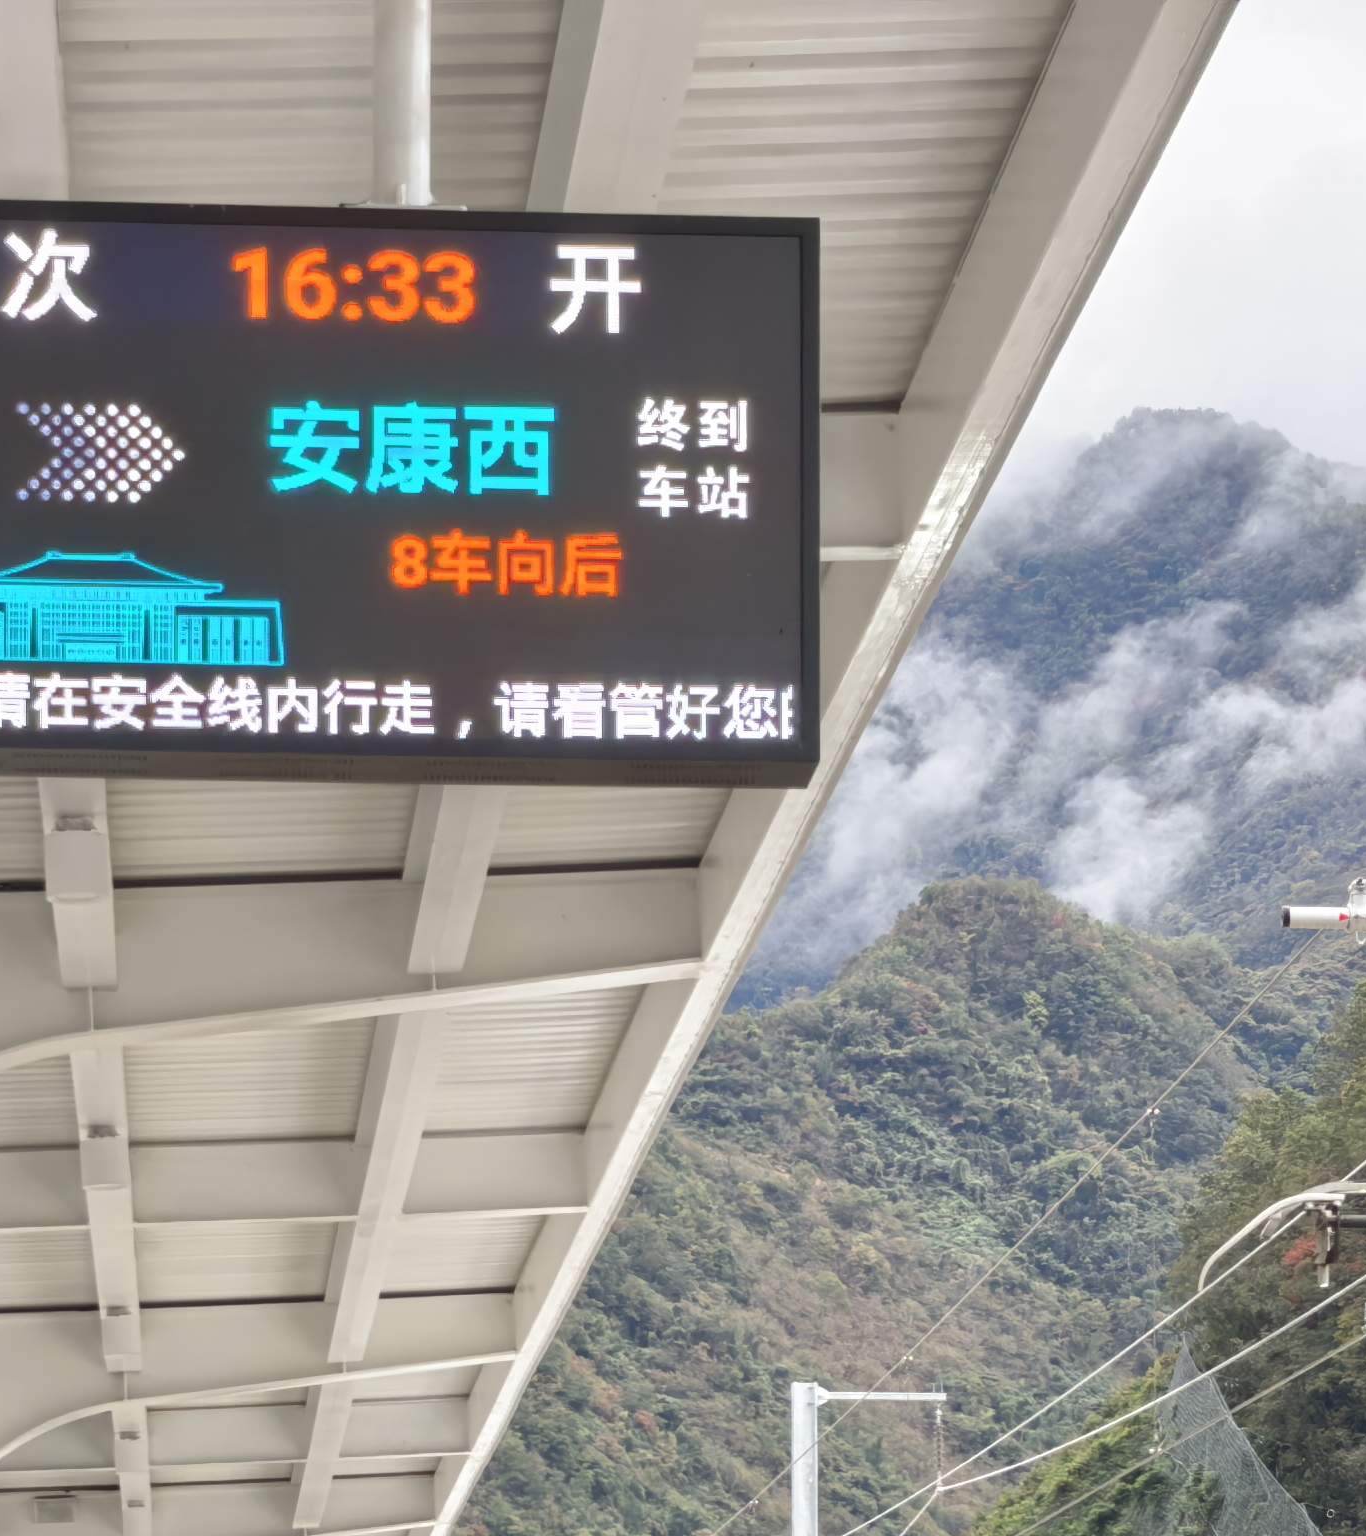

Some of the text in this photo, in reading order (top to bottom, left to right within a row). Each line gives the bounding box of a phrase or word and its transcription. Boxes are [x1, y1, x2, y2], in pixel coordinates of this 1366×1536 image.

[0, 228, 97, 322] 次
[231, 247, 476, 324] 16:33
[549, 244, 642, 334] 开
[268, 400, 557, 496] 安康西
[636, 397, 748, 452] 终到
[638, 464, 750, 519] 车站
[390, 528, 624, 598] 8车向后
